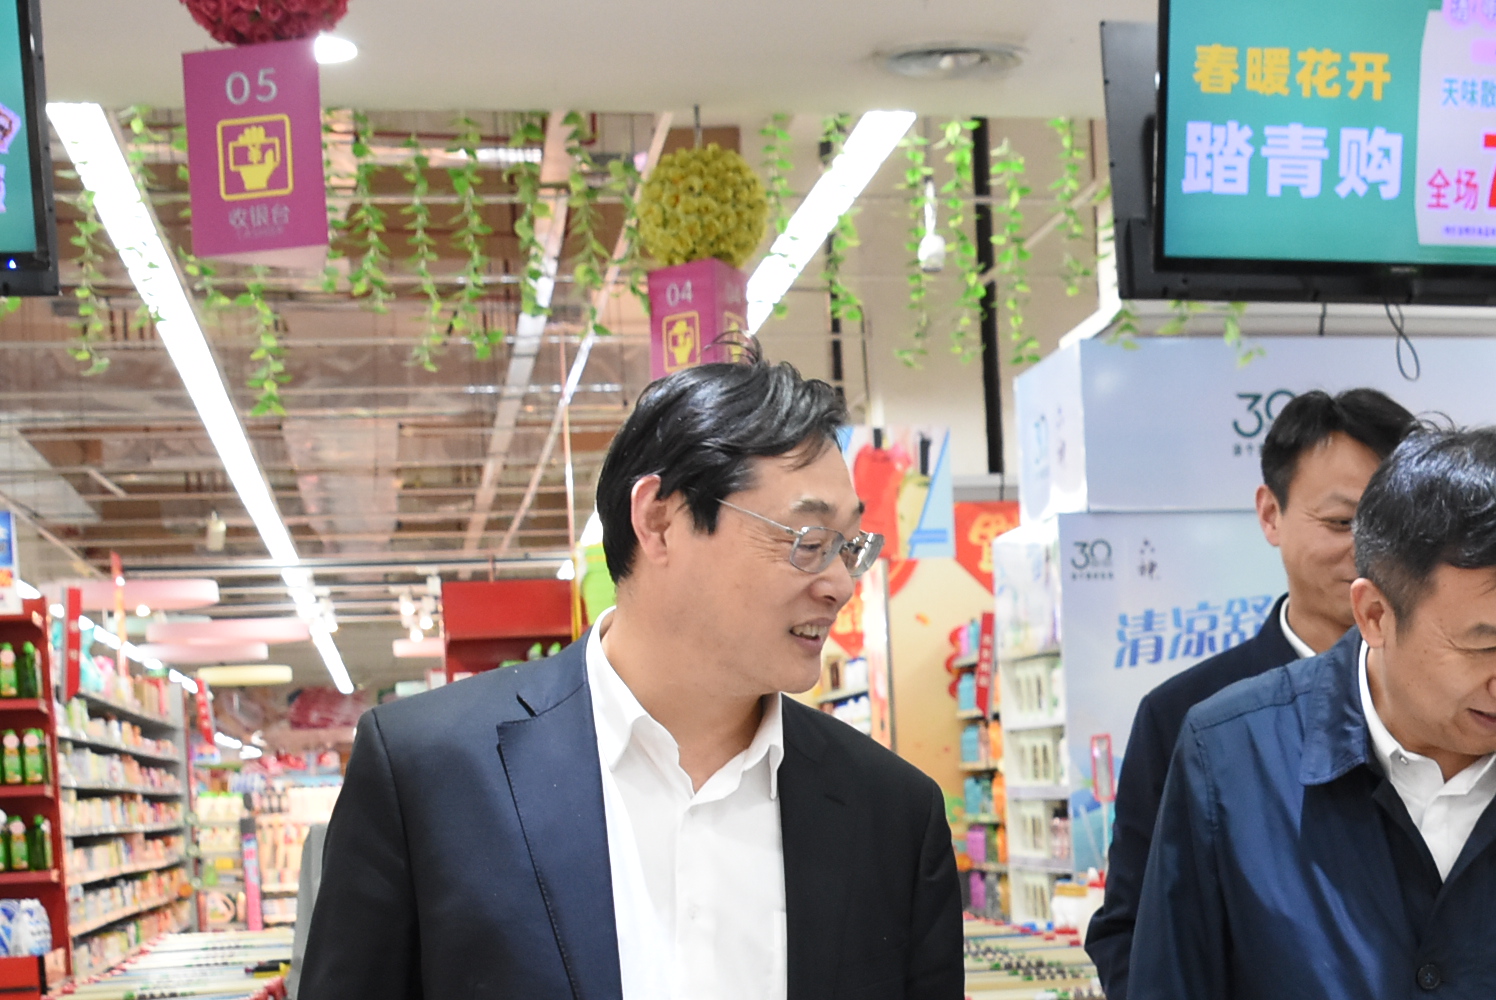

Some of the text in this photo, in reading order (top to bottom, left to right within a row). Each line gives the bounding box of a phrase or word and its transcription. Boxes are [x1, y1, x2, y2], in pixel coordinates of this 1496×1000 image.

[225, 67, 278, 105] 05
[1193, 44, 1391, 101] 春暖花开
[1181, 120, 1404, 200] 踏青购
[665, 280, 693, 308] 04
